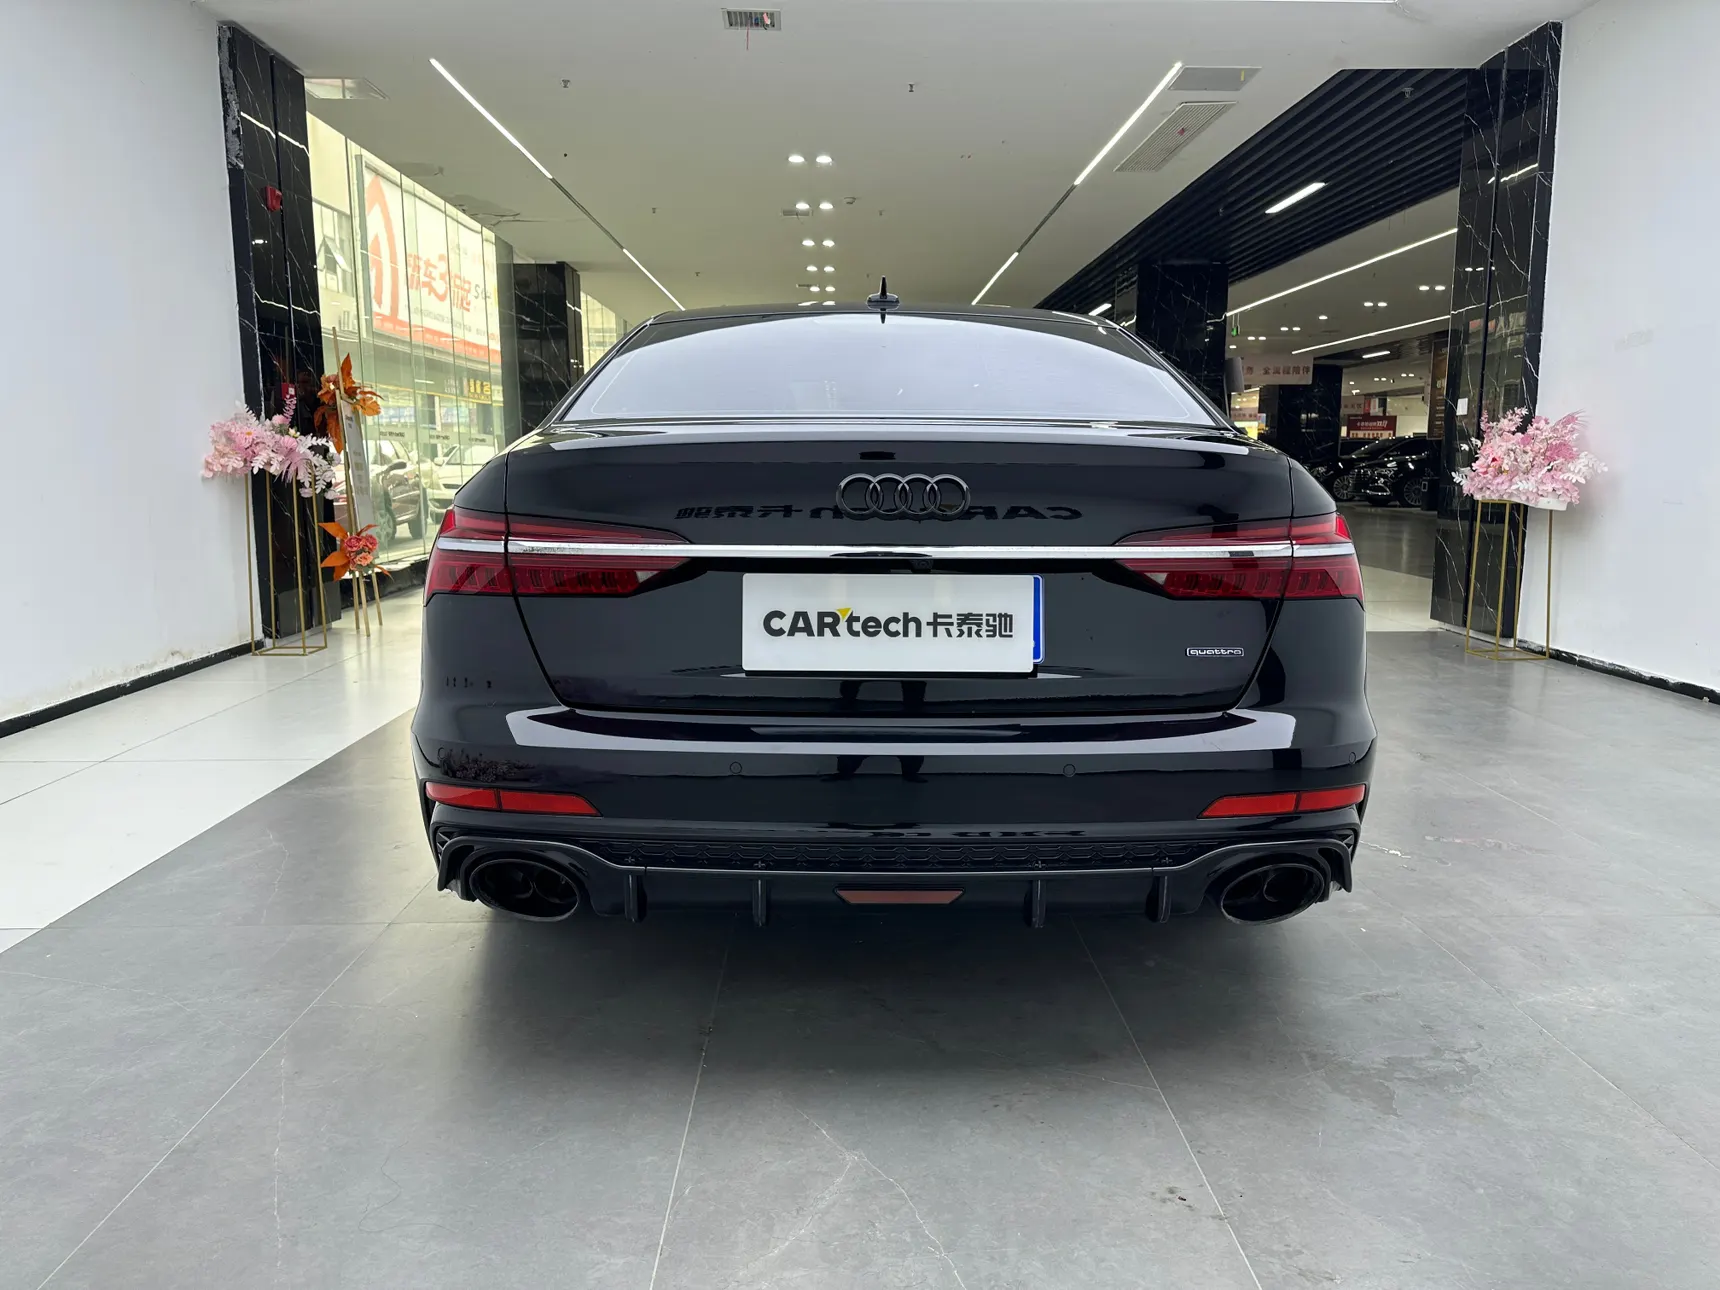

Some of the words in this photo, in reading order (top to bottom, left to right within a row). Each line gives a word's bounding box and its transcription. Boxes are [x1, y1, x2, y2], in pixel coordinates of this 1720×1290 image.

[763, 608, 922, 638] CARtech
[926, 612, 1014, 638] 卡泰驰
